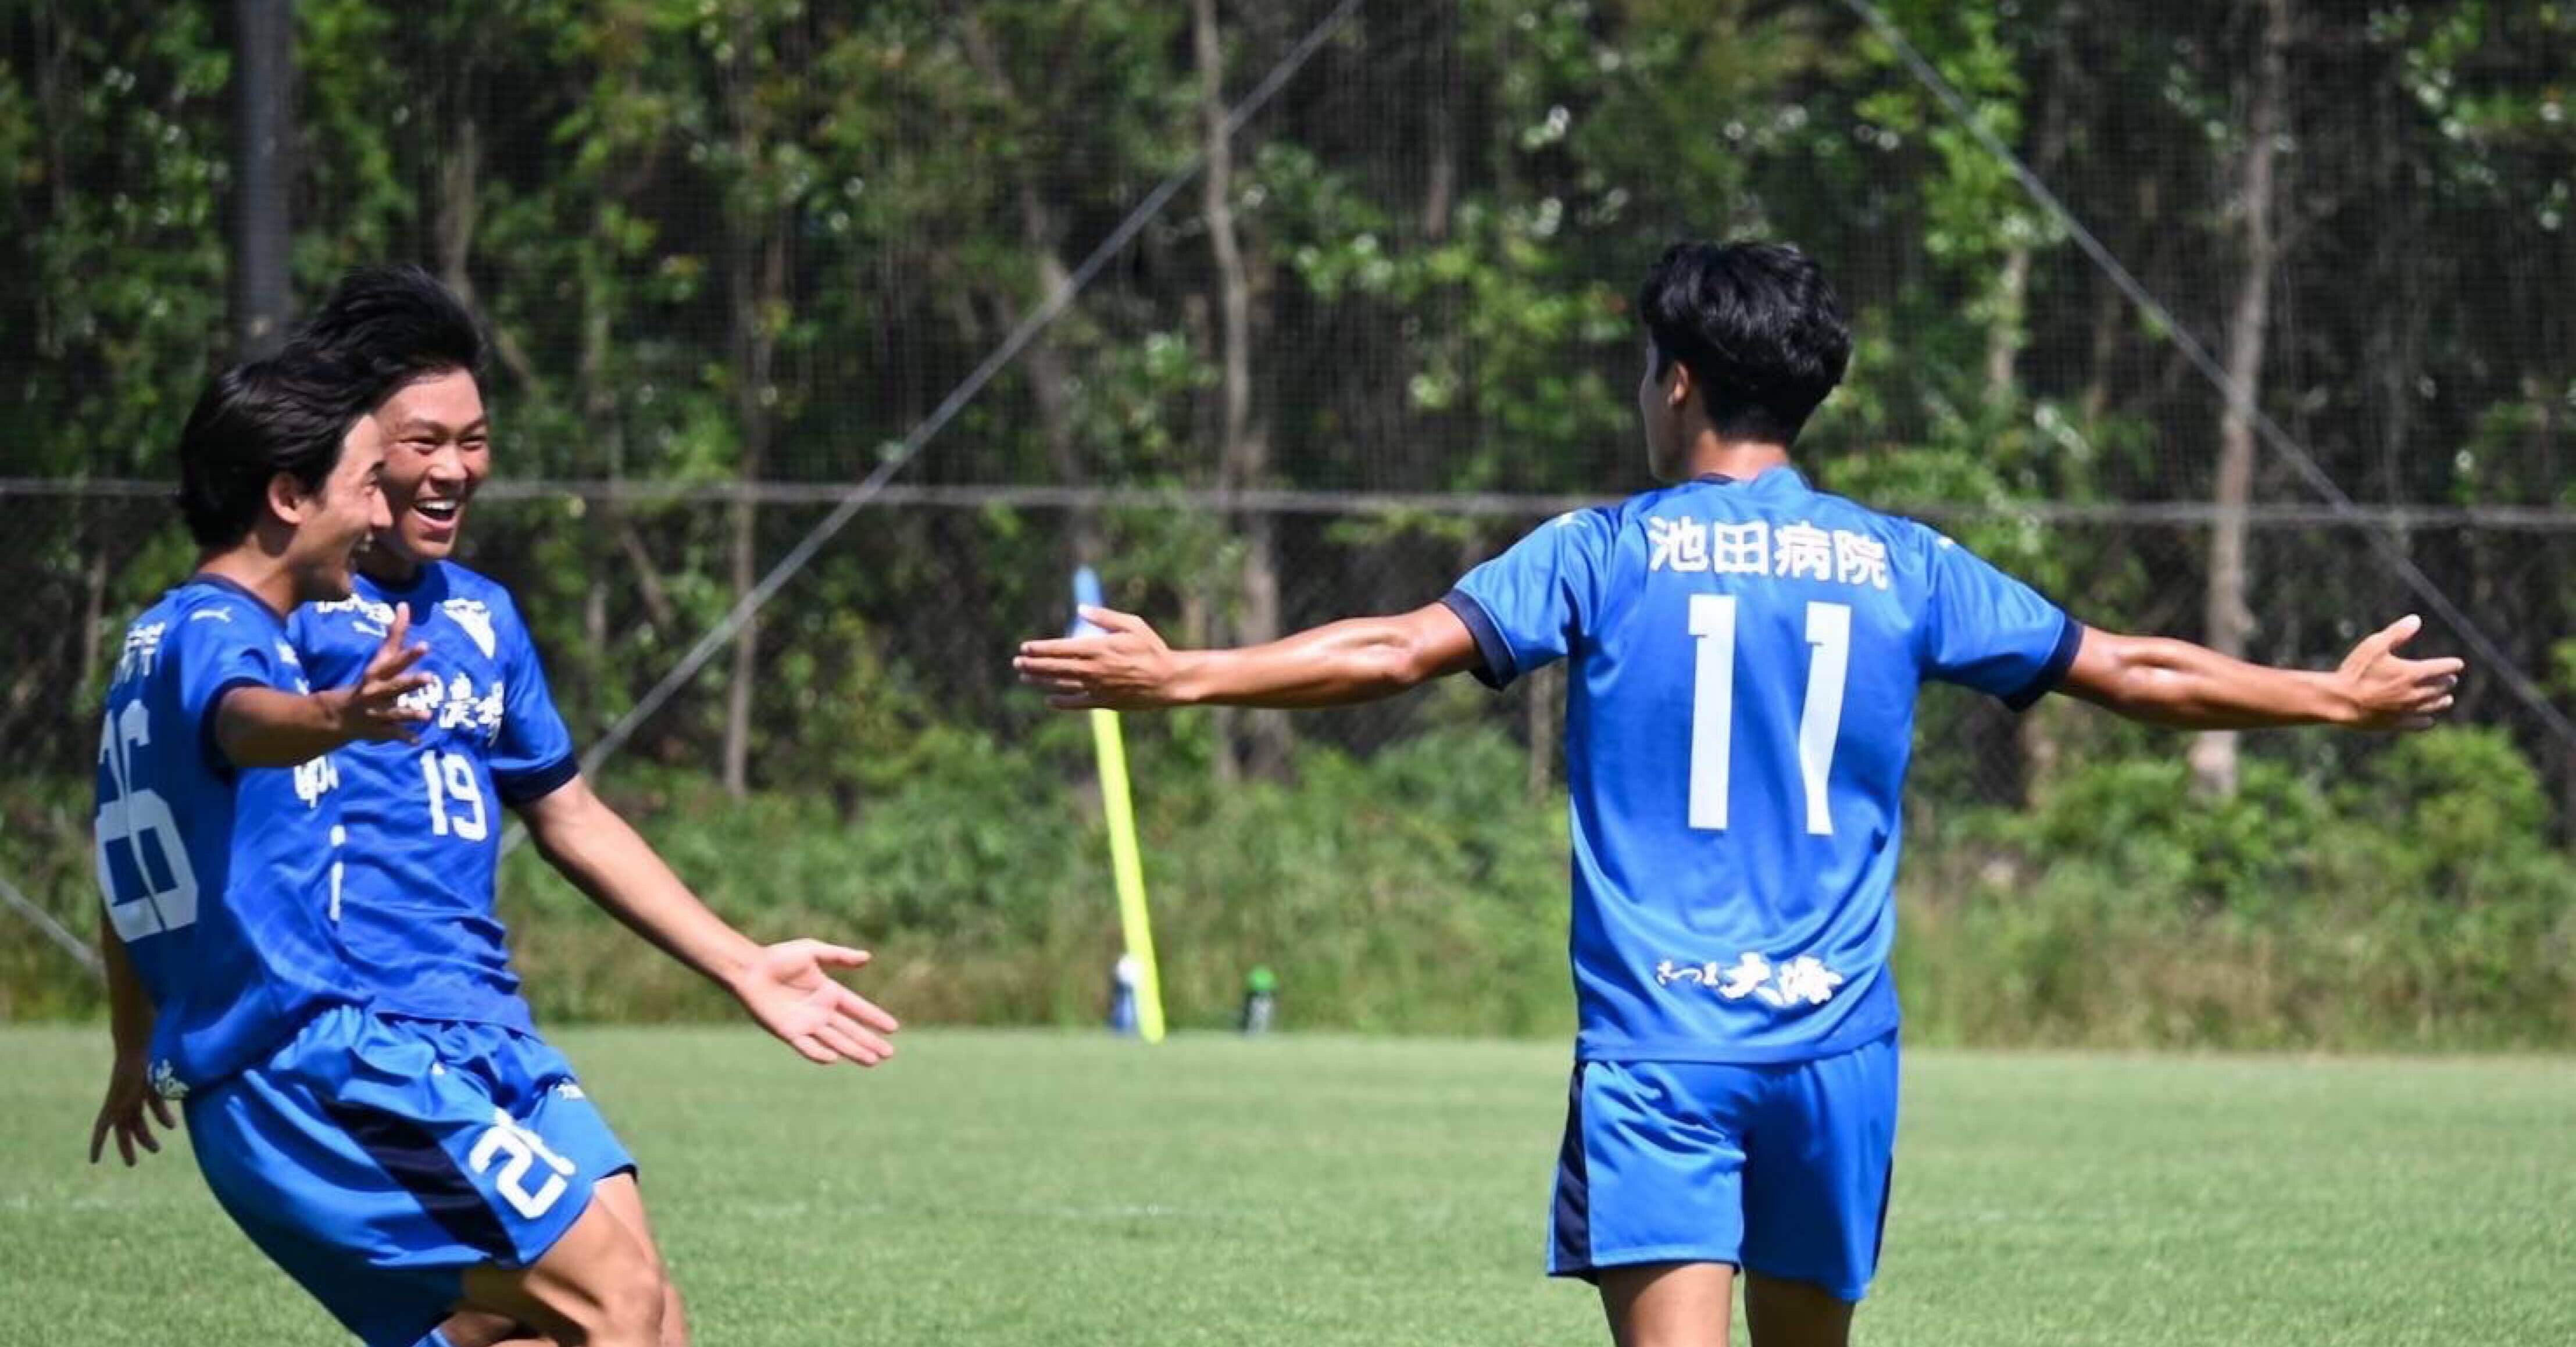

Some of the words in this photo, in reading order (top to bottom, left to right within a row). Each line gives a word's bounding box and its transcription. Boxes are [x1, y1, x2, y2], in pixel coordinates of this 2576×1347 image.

[1648, 515, 1889, 591] 池田病院
[420, 749, 488, 842] 19
[1688, 594, 1852, 835] 11
[94, 698, 198, 943] 26
